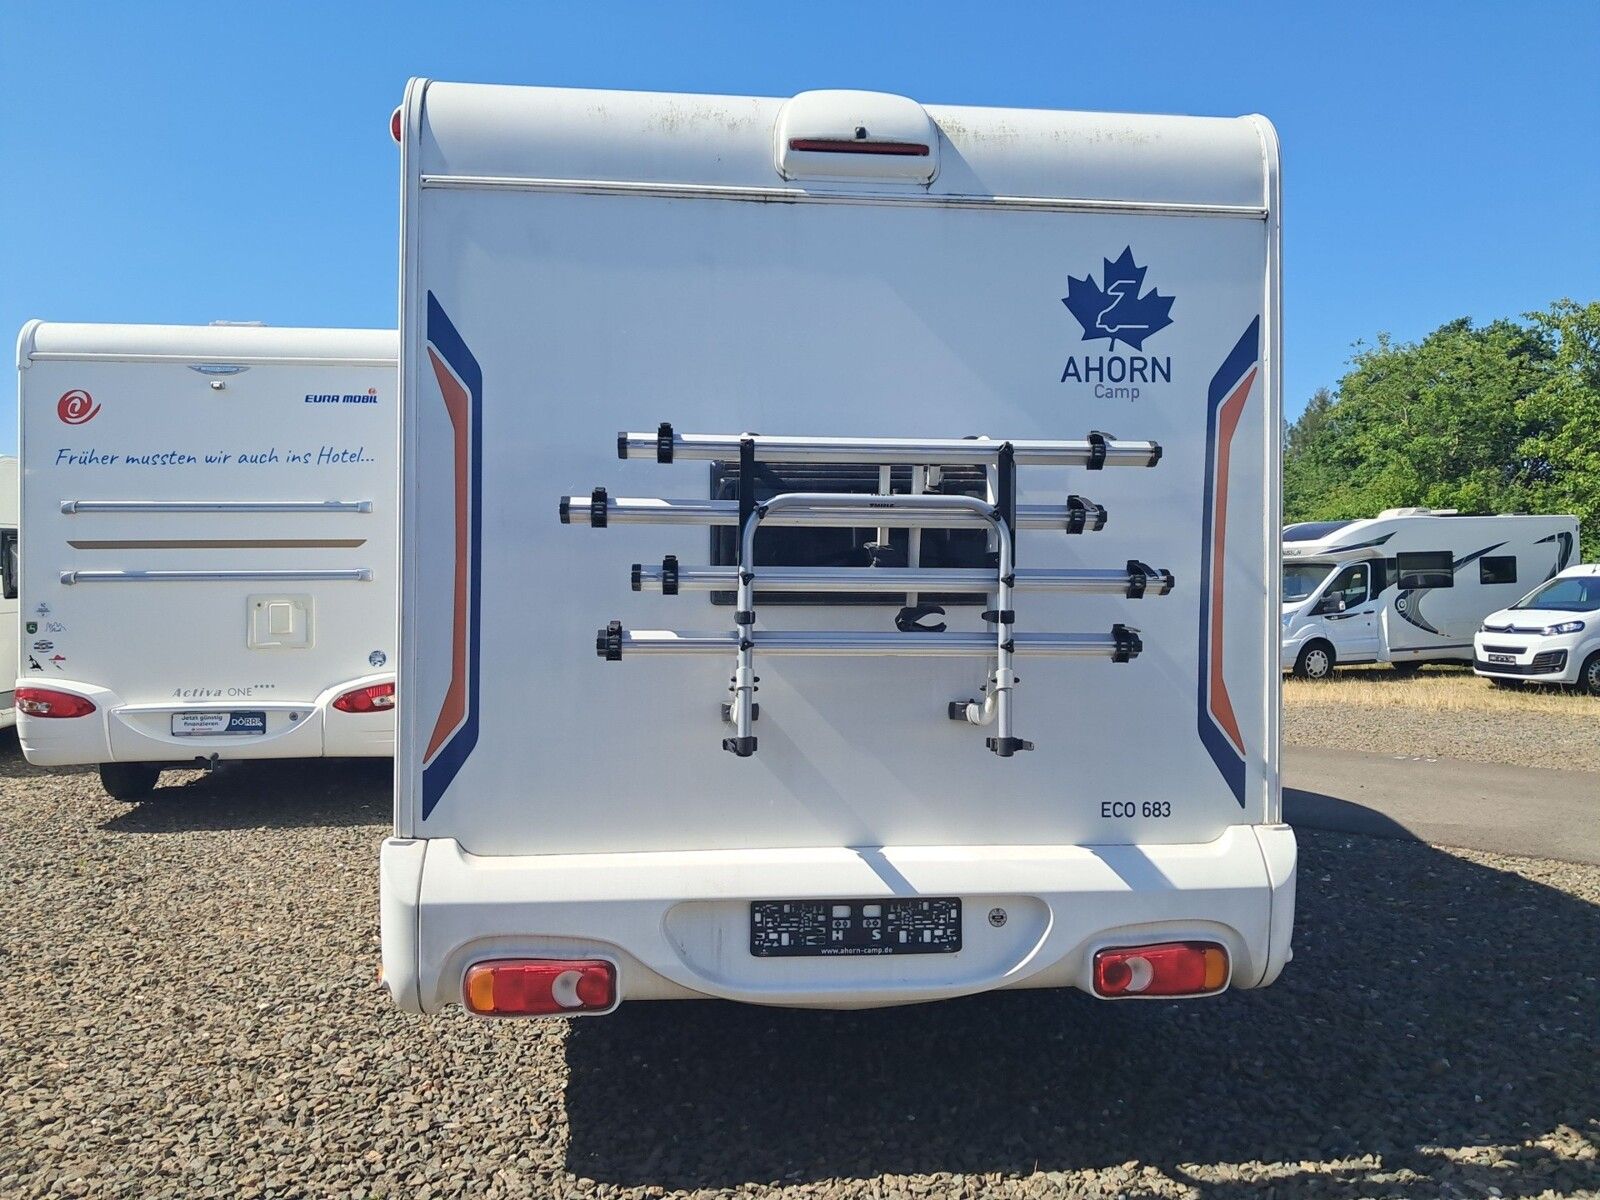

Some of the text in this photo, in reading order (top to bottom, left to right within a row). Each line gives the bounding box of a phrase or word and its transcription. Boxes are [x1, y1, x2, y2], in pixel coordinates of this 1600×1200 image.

[1061, 355, 1171, 383] AHORN
[304, 394, 378, 403] EURA MOBIL
[1094, 384, 1140, 402] Camp
[55, 448, 119, 466] Früher
[125, 450, 197, 466] mussten
[204, 450, 232, 465] wir
[238, 447, 279, 464] auch
[286, 450, 312, 464] ins
[172, 687, 252, 697] Activa ONE
[1101, 801, 1171, 818] ECO 683
[821, 946, 894, 955] www.ahorn-camp.de
